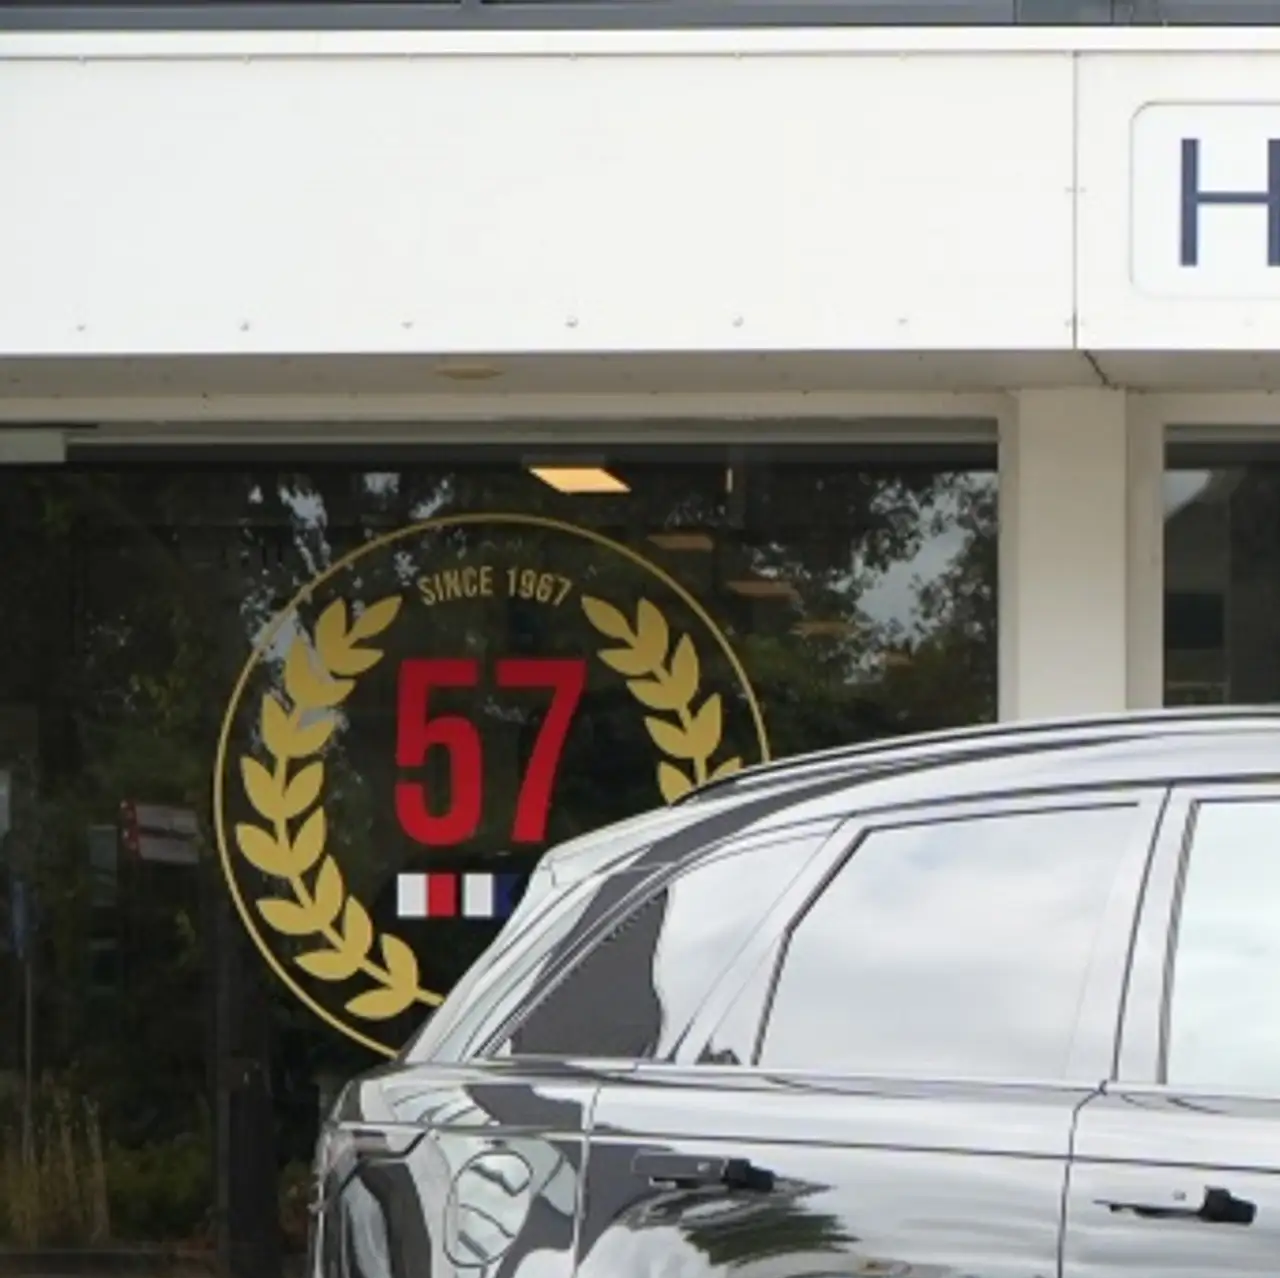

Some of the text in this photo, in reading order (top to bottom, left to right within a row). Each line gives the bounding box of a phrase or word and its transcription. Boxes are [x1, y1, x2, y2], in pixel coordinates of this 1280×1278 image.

[417, 566, 574, 607] SINCE 1967
[395, 660, 585, 845] 57
